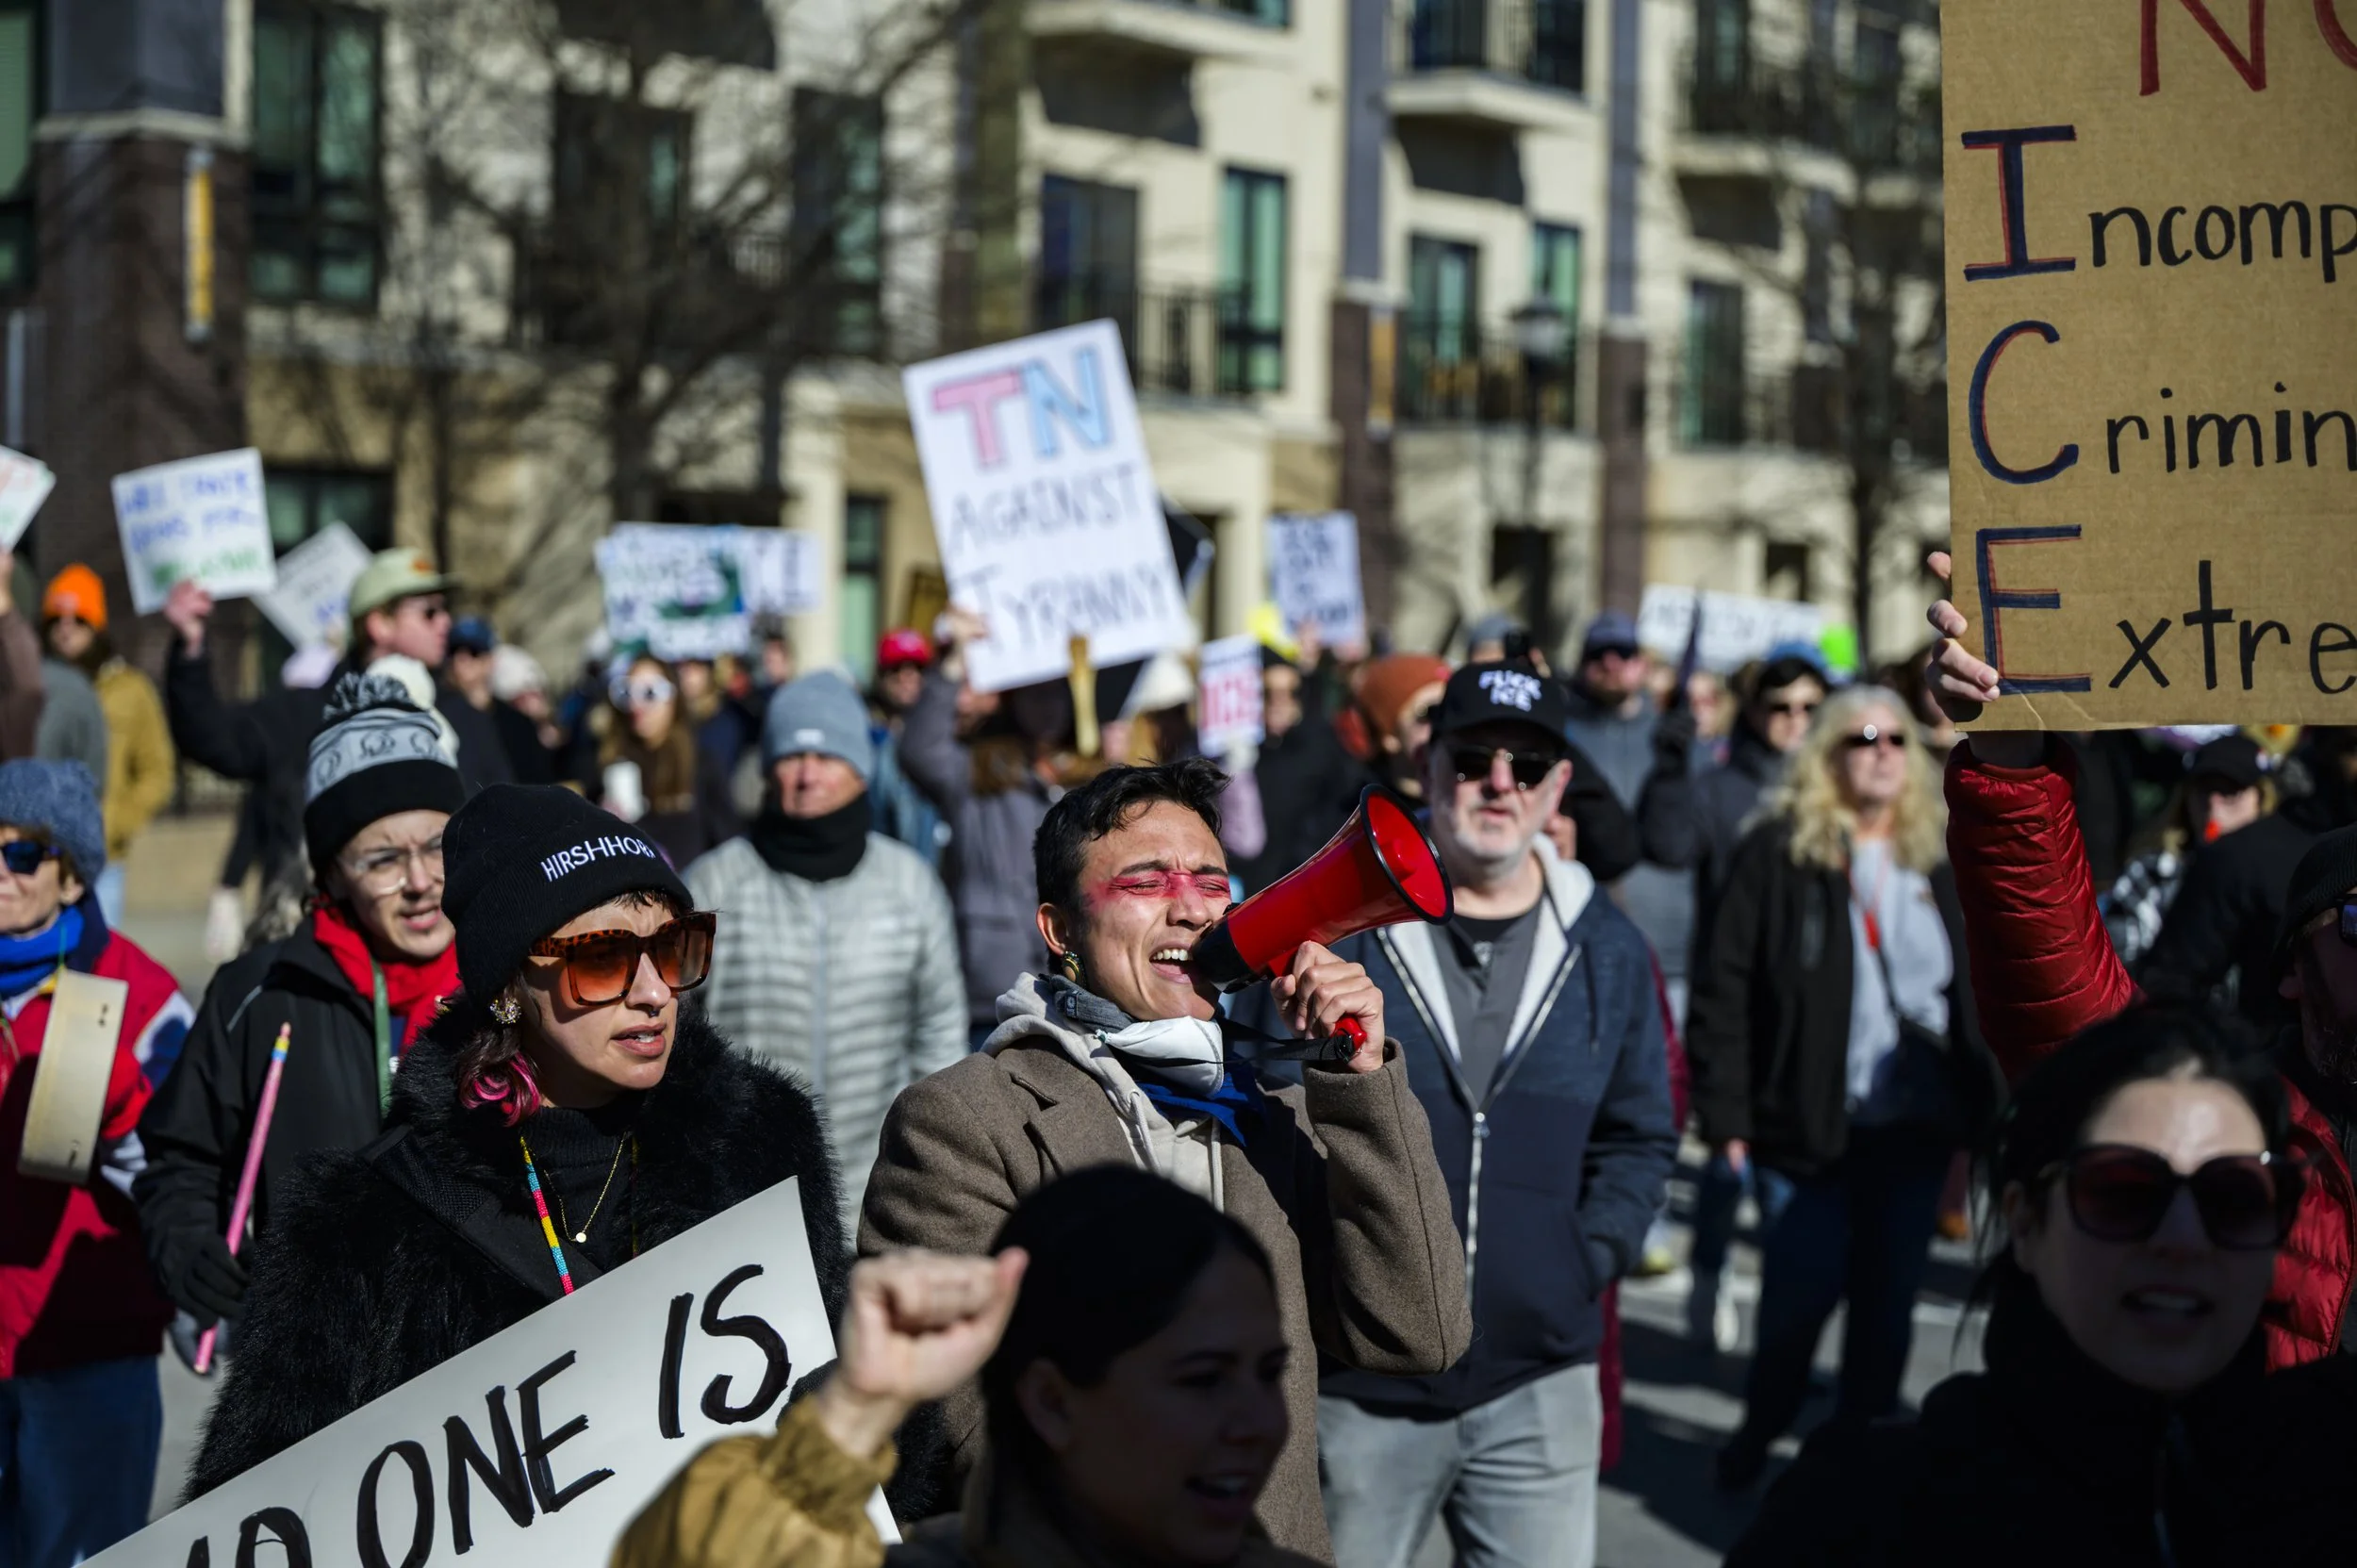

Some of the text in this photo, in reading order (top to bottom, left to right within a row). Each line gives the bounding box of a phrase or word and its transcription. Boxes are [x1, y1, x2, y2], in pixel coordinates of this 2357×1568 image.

[2139, 0, 2357, 95] N
[931, 344, 1113, 468] TN
[1478, 669, 1541, 700] FUCK
[1490, 685, 1532, 712] ICE
[356, 1264, 792, 1568] ONE IS
